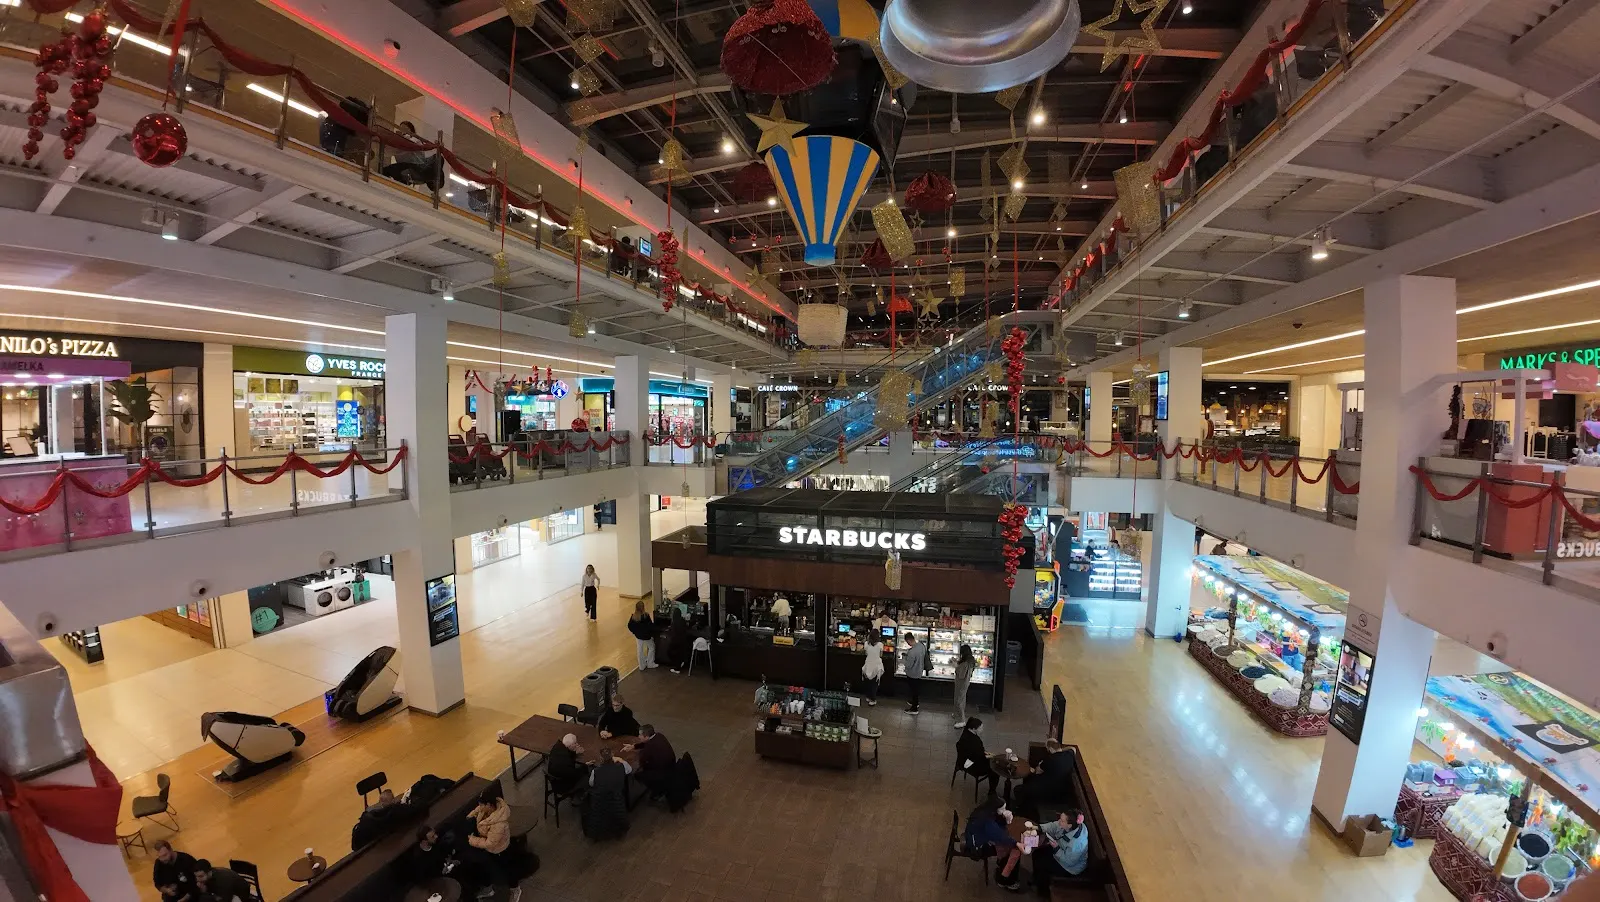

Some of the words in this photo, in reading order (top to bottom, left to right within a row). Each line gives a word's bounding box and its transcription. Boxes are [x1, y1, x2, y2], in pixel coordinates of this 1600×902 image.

[61, 339, 118, 357] PIZZA
[327, 358, 356, 370] YVES
[351, 370, 382, 378] FRANCE
[779, 527, 926, 550] STARBUCKS
